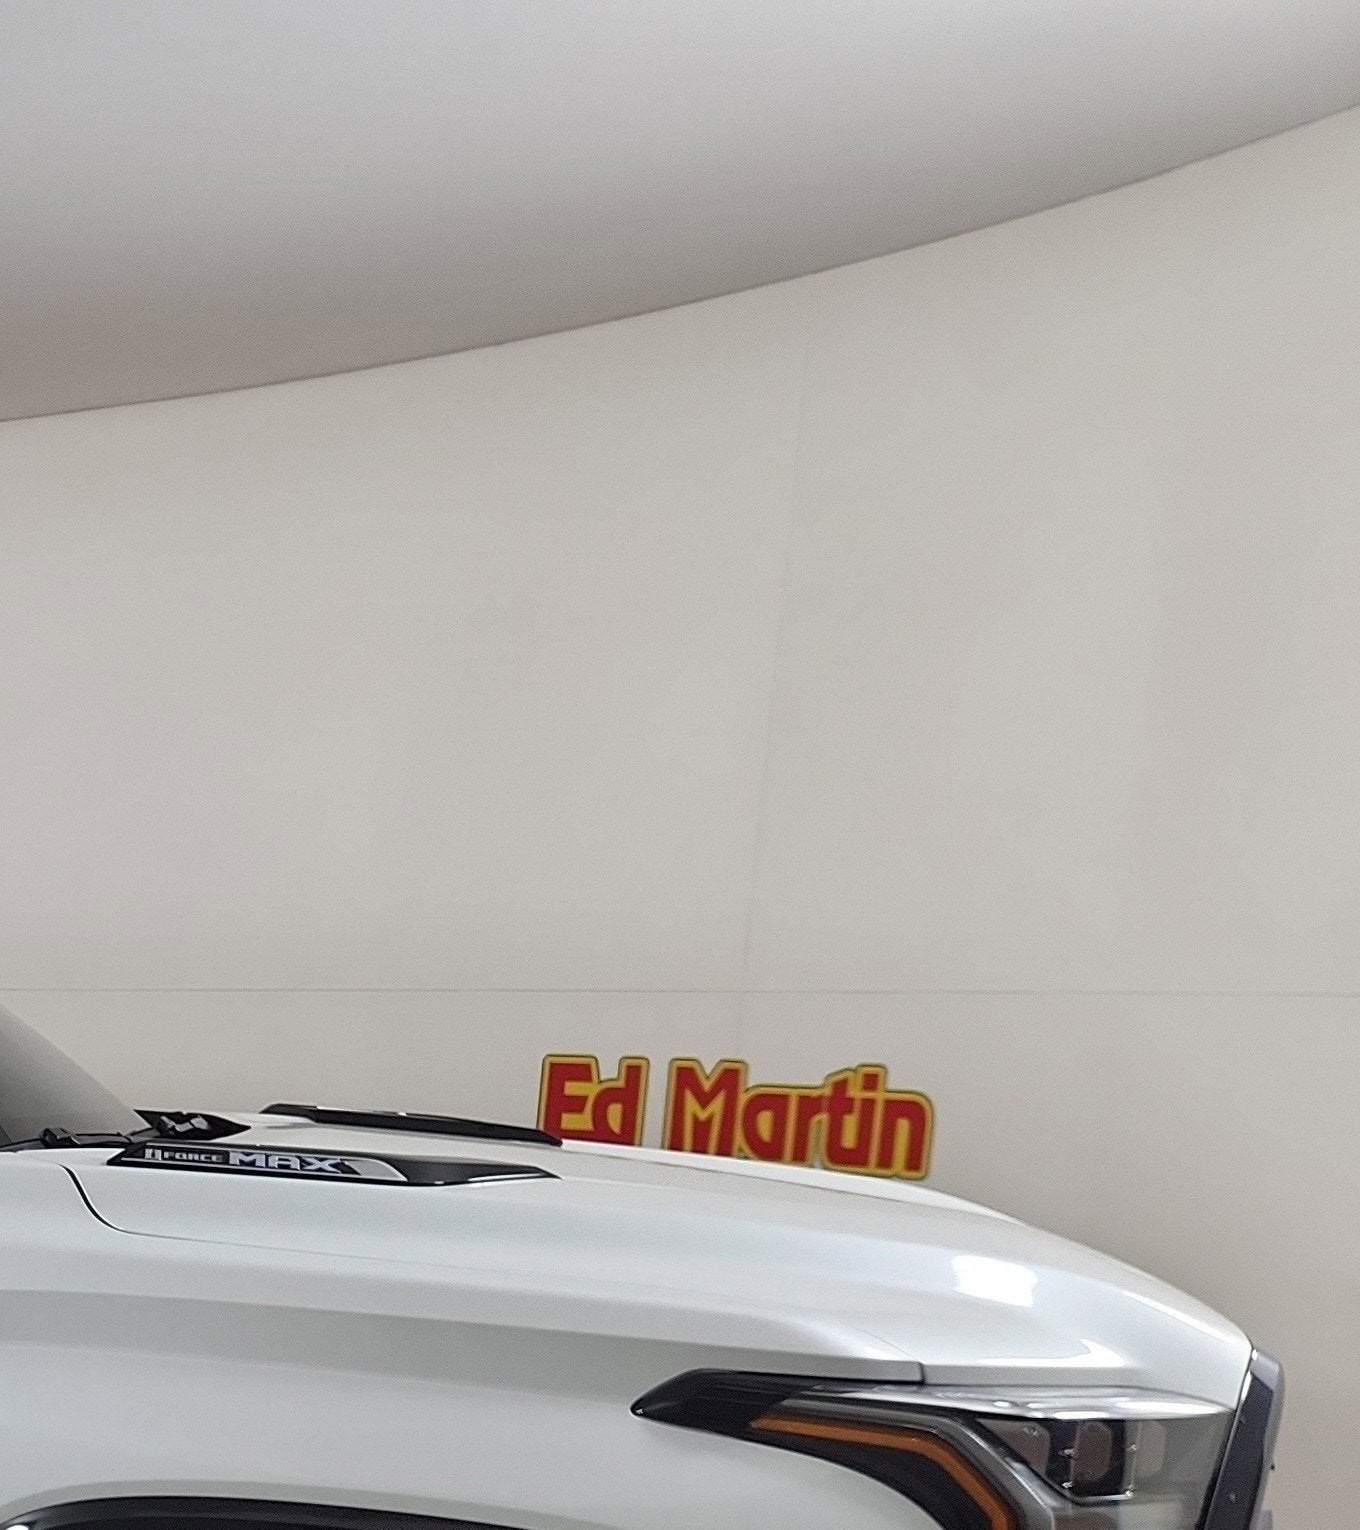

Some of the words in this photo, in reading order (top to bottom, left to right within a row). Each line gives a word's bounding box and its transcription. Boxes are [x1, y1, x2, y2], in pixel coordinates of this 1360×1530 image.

[540, 1058, 646, 1146] Ed
[665, 1062, 930, 1176] Martin
[228, 1149, 342, 1174] MAX
